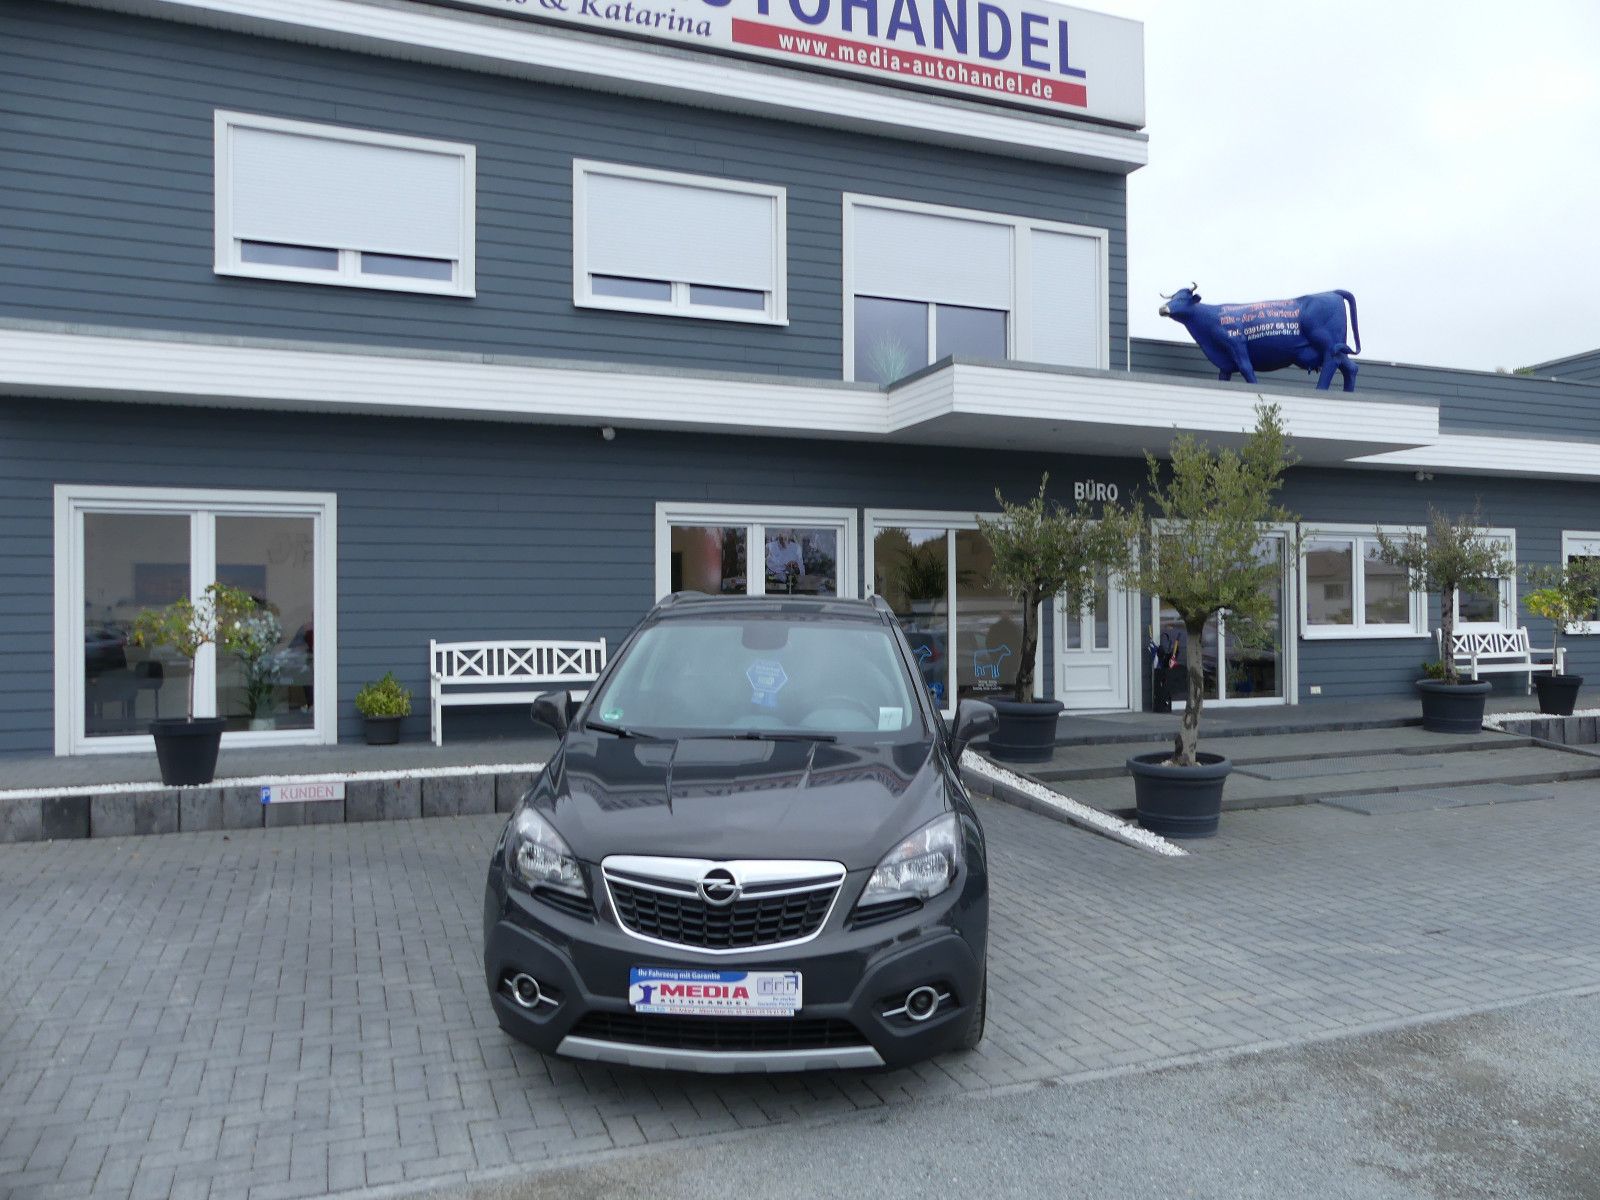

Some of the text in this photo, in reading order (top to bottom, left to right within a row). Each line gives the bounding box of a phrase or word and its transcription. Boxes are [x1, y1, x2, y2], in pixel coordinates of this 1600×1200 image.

[577, 0, 712, 38] Katarina
[778, 31, 1054, 99] www.media-autohandel.de
[1227, 329, 1241, 338] Tel.
[1286, 322, 1299, 330] 100
[1074, 479, 1119, 502] BÜRO
[280, 786, 334, 800] KUNDEN
[638, 968, 721, 980] Ihr Fahrzeug mit Garantie
[660, 983, 750, 999] MEDIA
